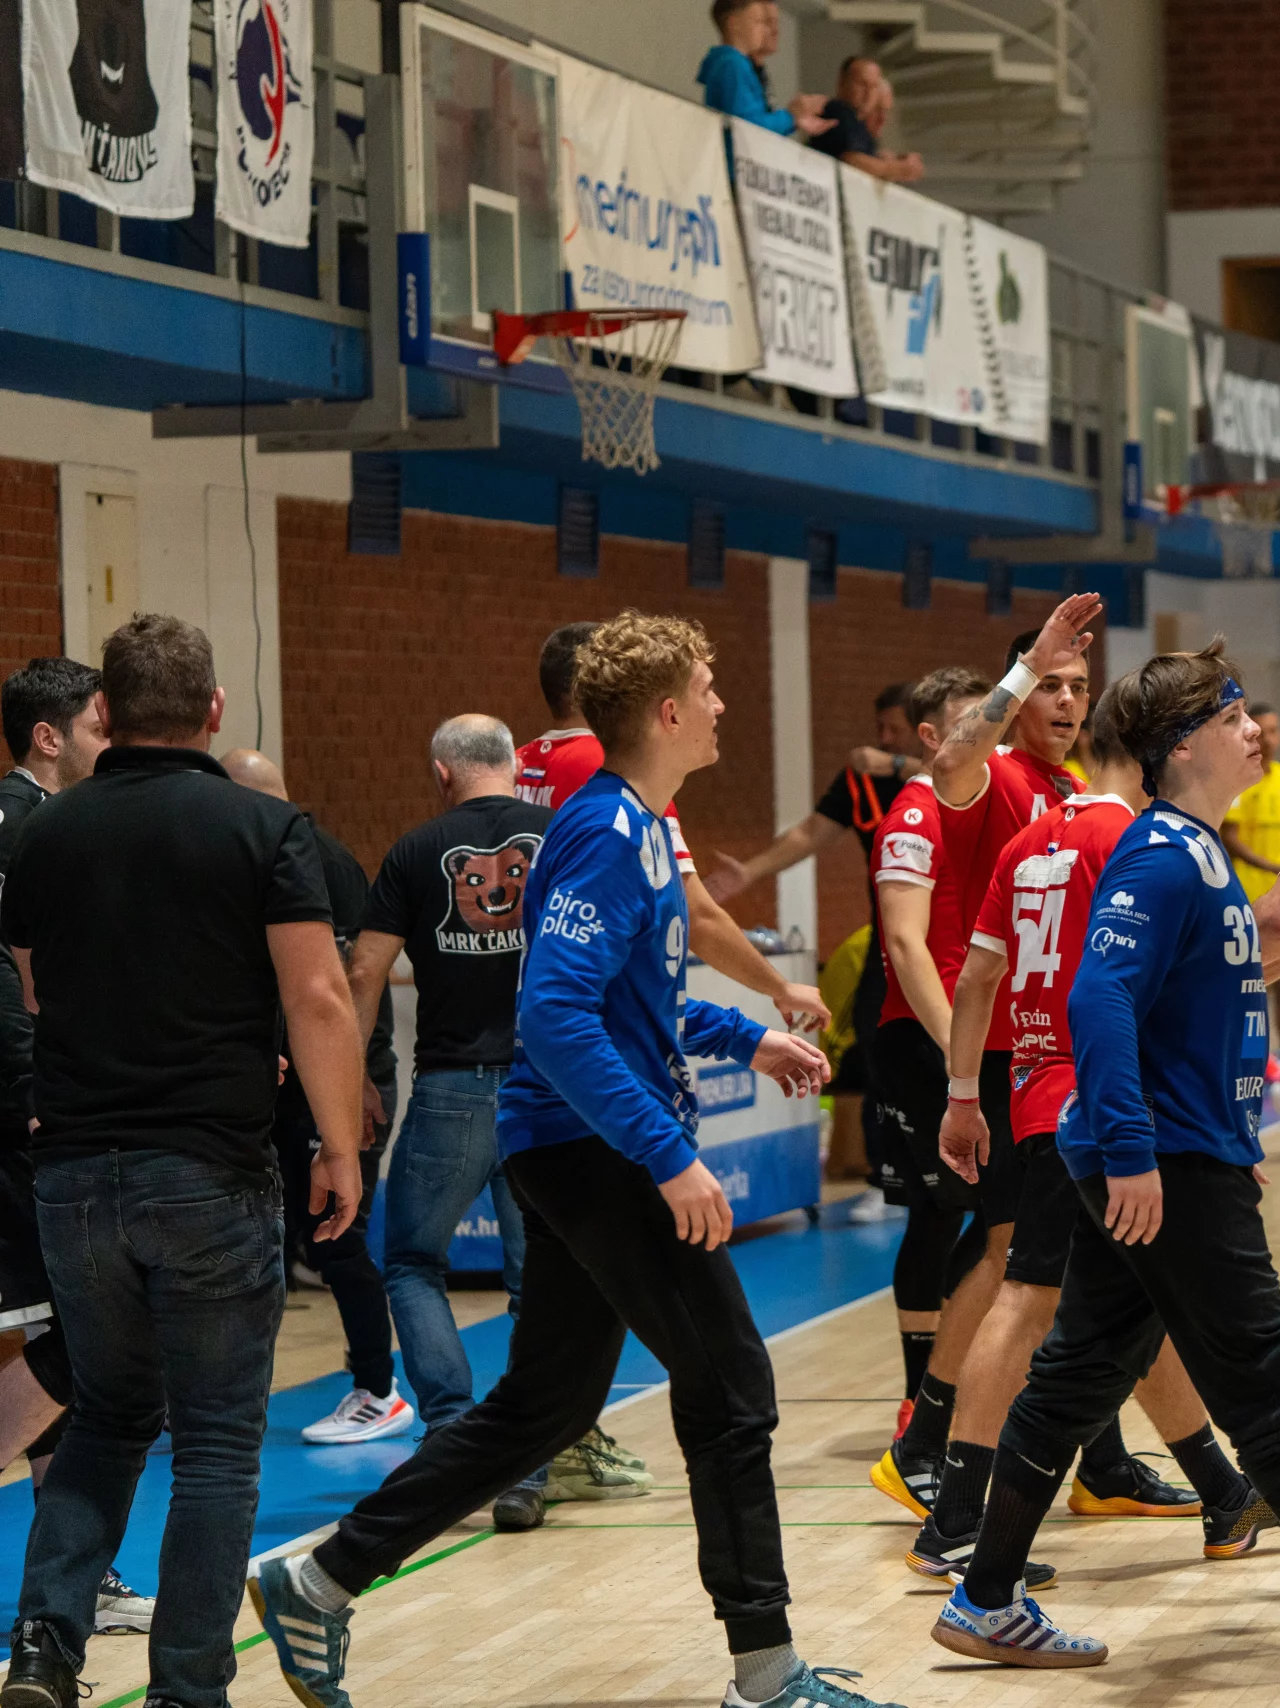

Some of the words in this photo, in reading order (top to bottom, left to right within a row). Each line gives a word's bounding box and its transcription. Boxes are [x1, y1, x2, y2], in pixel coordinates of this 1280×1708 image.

[550, 888, 597, 918] biro
[440, 930, 482, 951] MRK
[1011, 888, 1067, 993] 54
